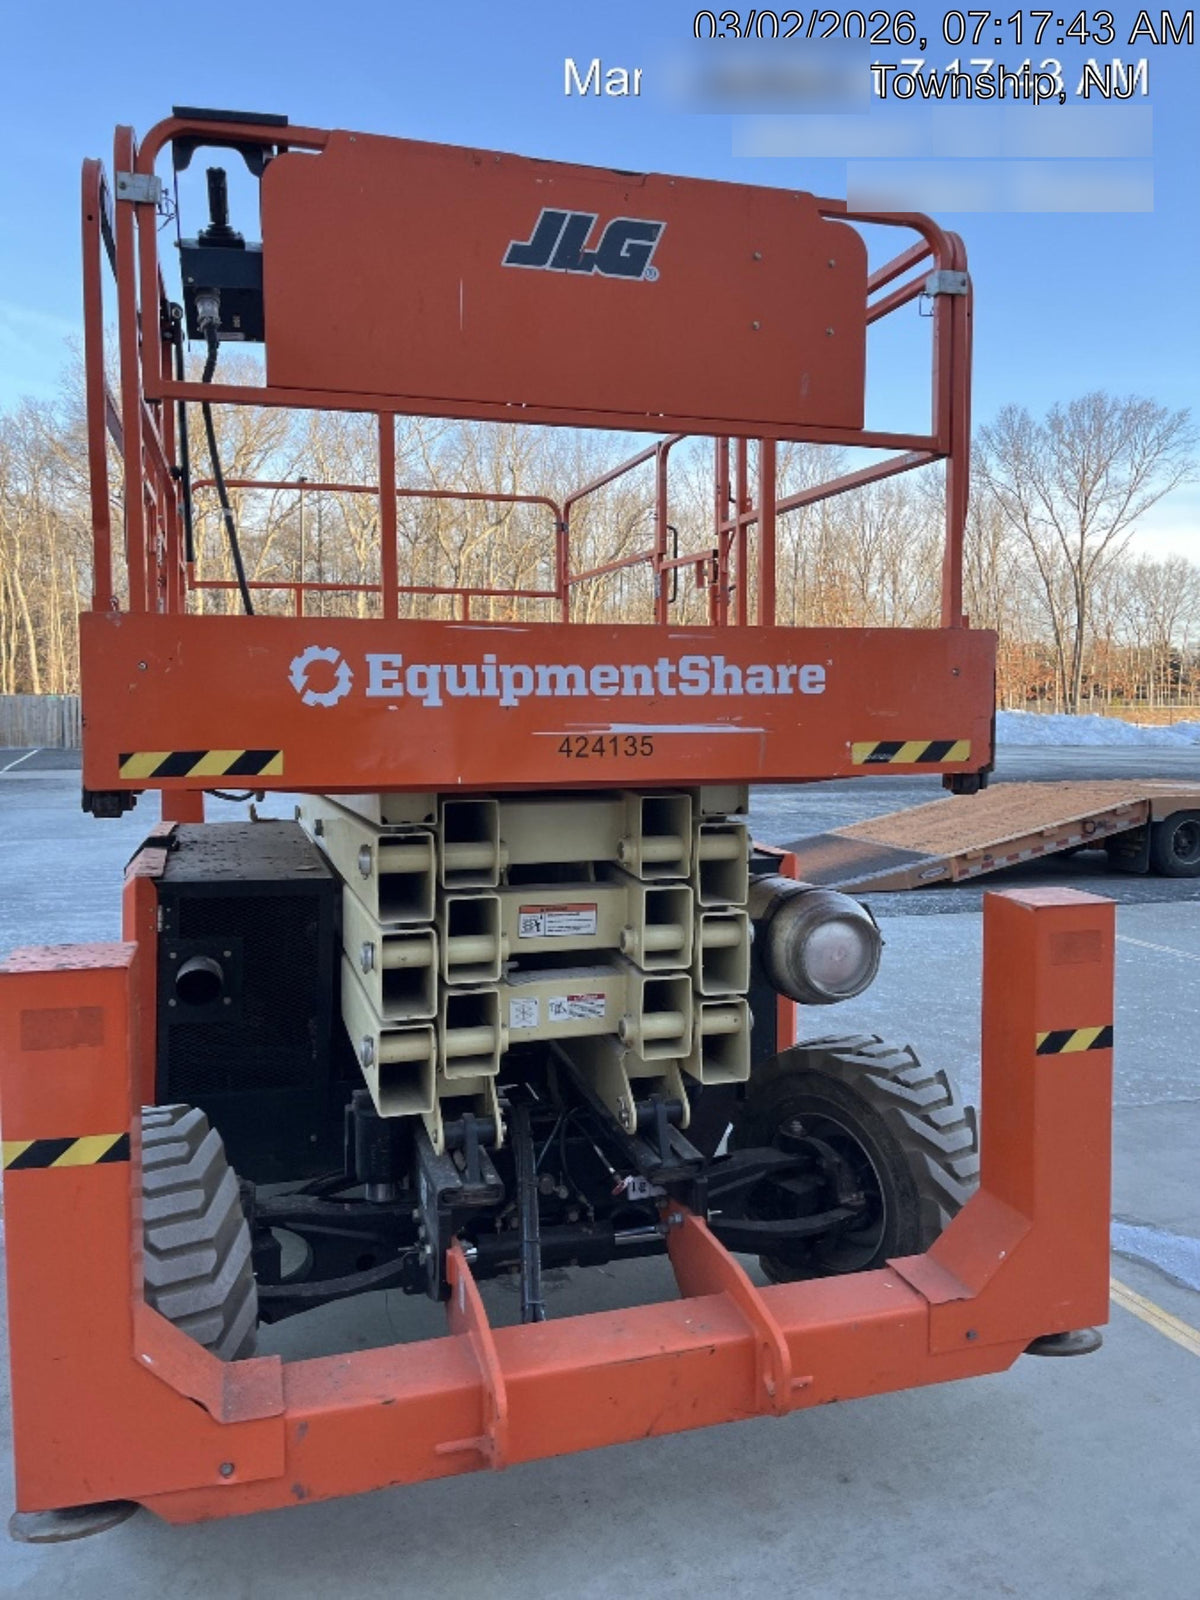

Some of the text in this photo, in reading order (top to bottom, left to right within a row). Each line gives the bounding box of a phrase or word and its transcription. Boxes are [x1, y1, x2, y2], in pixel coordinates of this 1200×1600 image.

[501, 207, 667, 281] JLG
[365, 653, 826, 707] EquipmentShare
[558, 735, 654, 759] 424135
